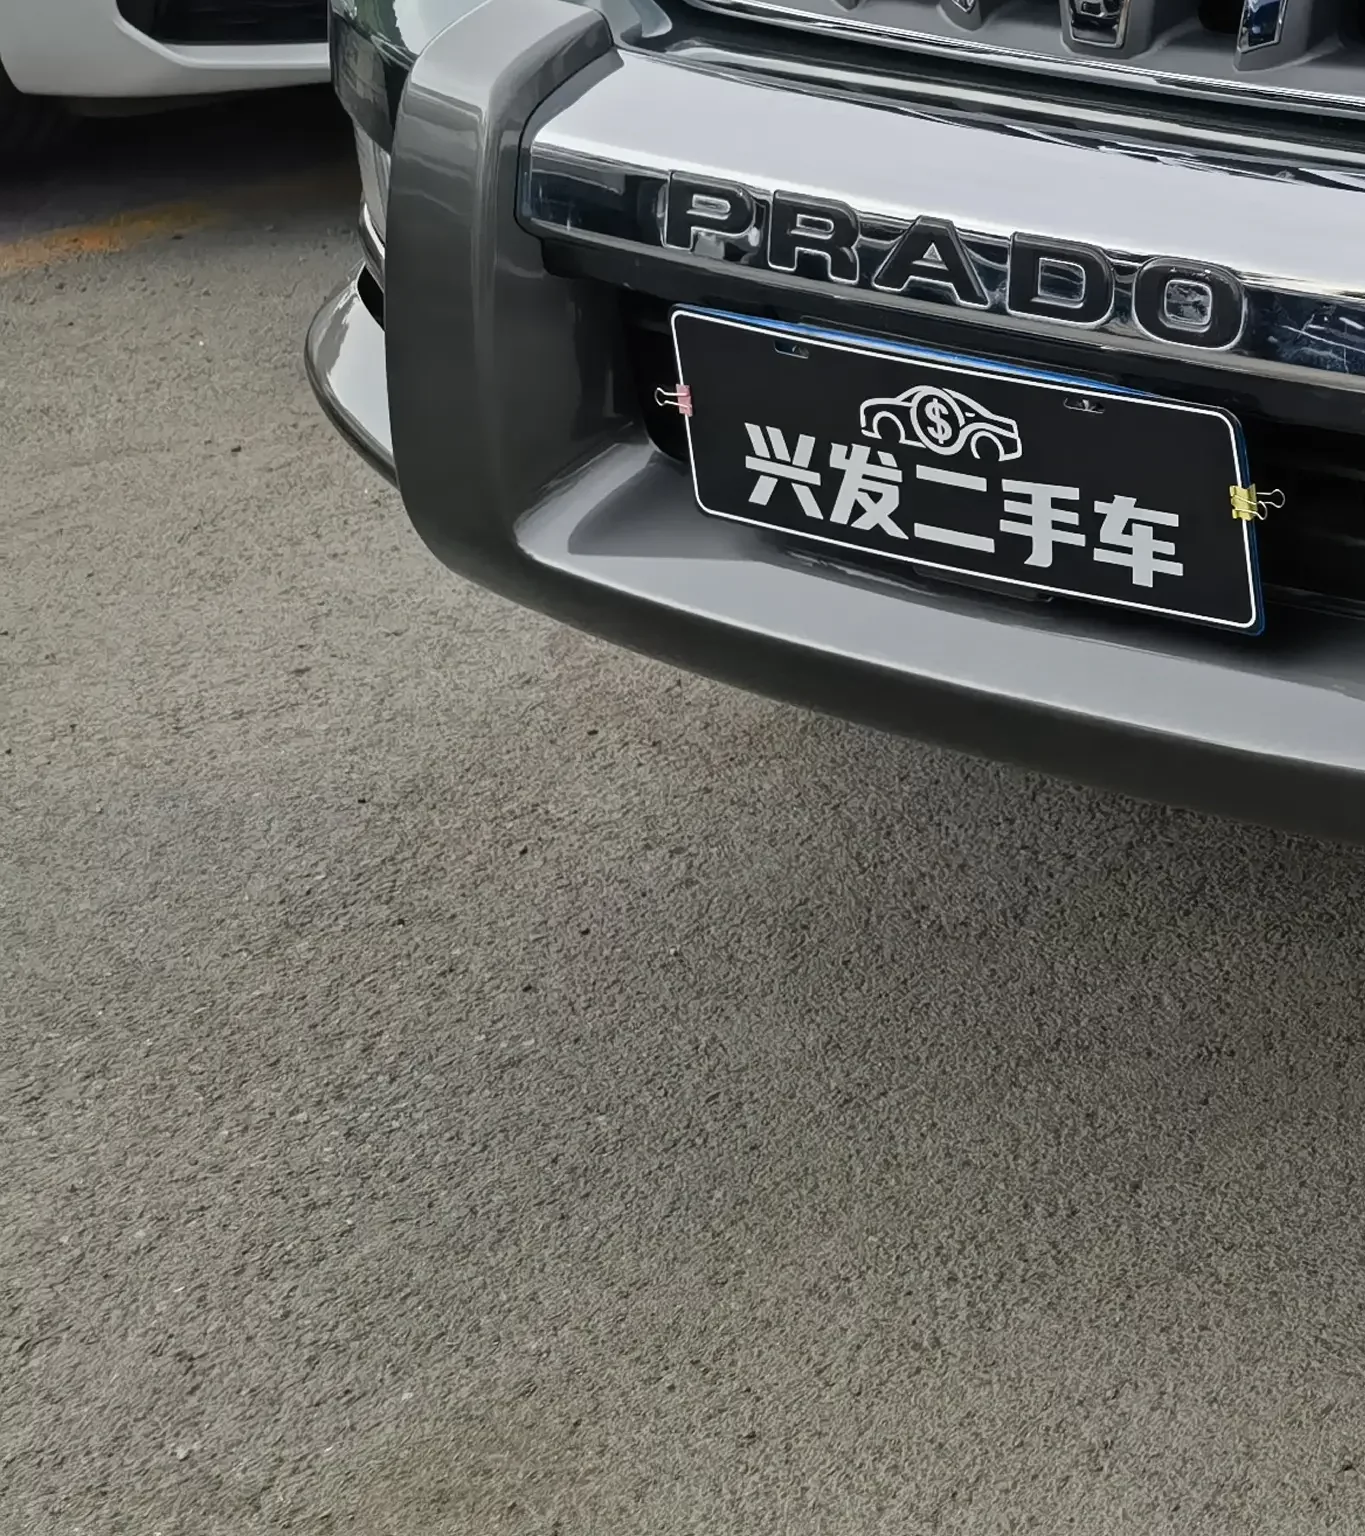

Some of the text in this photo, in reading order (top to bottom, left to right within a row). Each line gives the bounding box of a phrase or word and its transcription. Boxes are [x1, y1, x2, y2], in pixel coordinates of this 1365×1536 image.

[661, 170, 1246, 351] PRADO
[744, 421, 1184, 588] 兴发二手车
